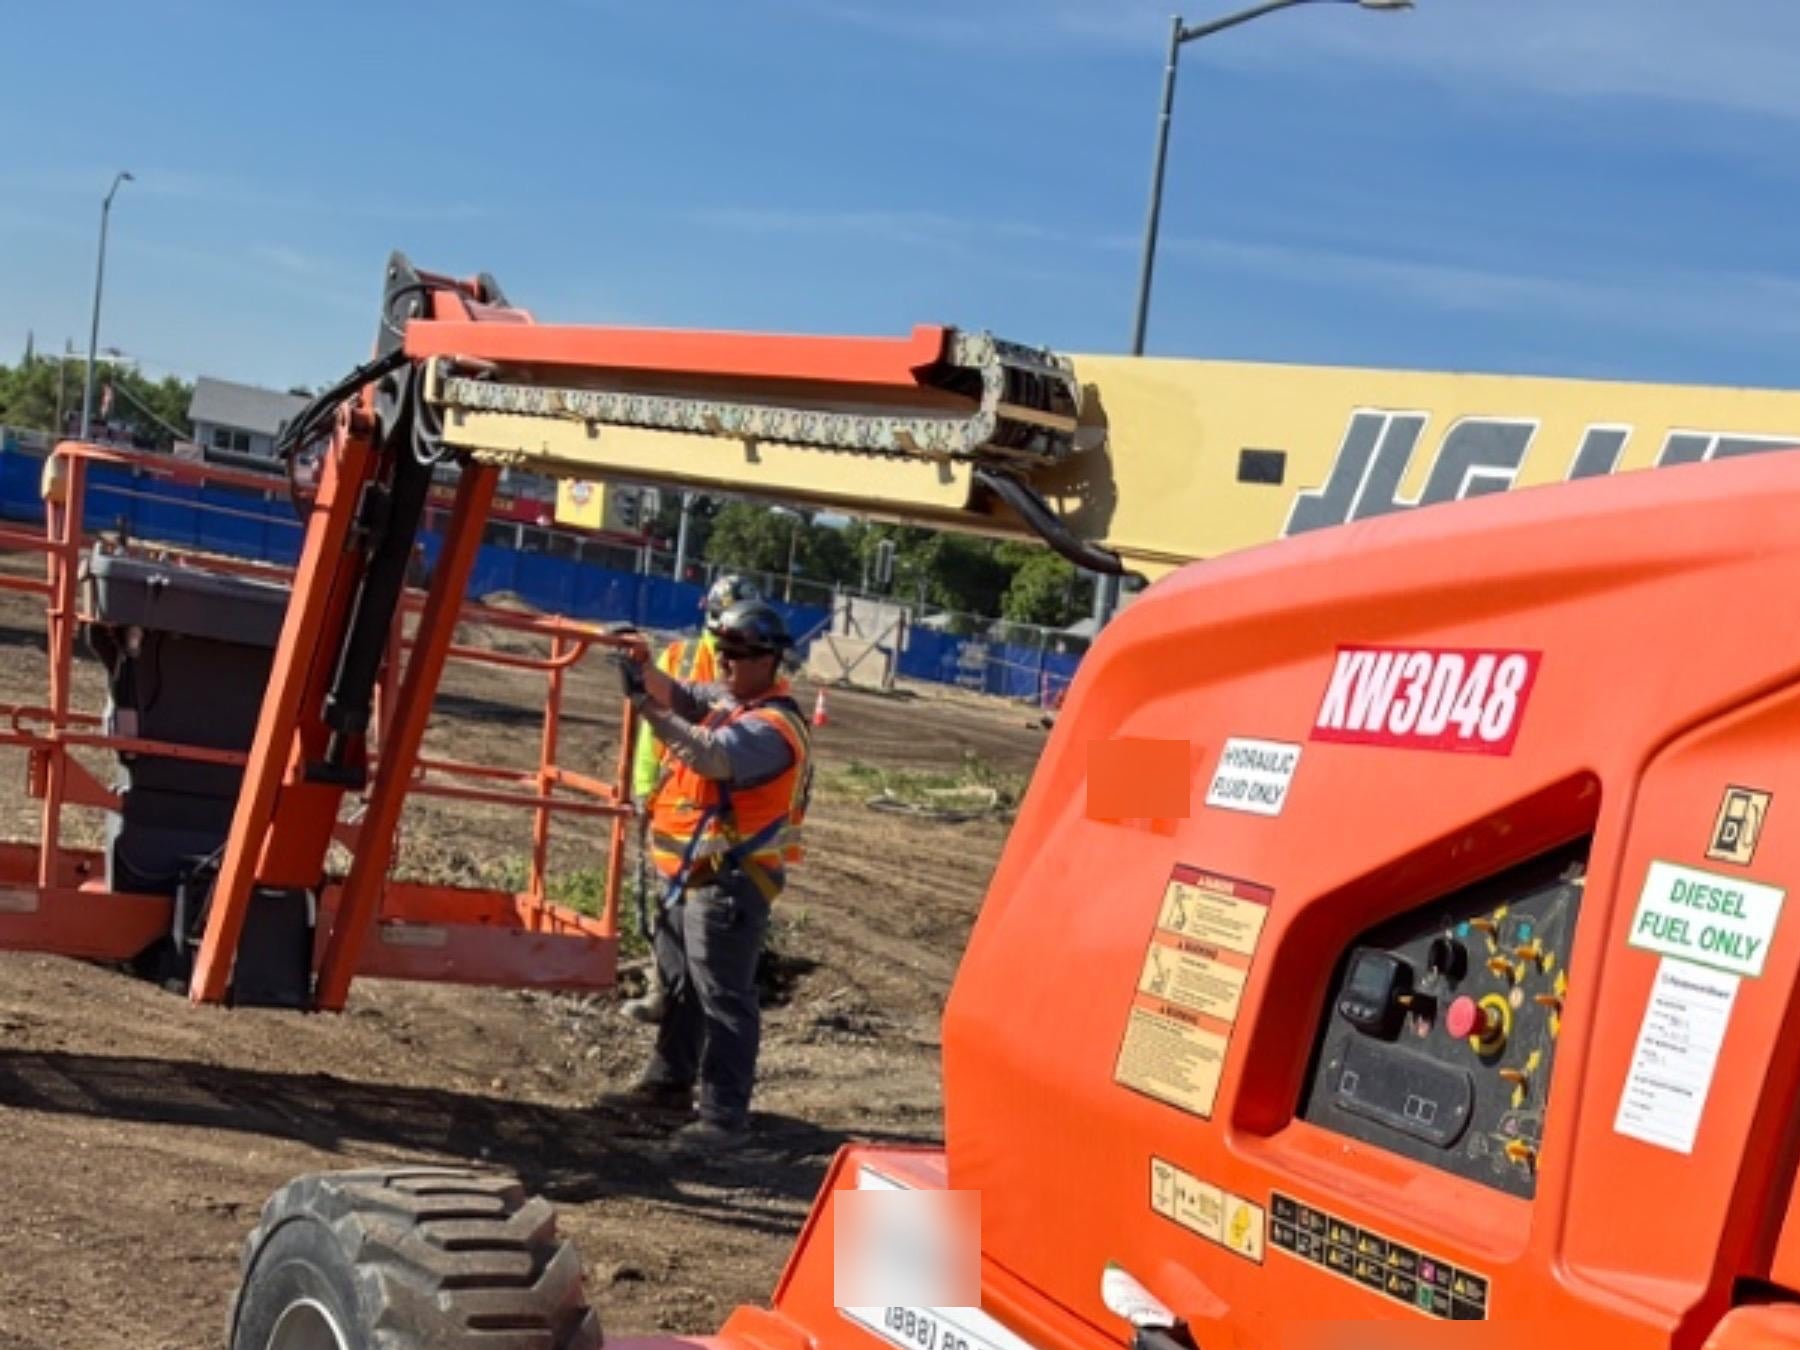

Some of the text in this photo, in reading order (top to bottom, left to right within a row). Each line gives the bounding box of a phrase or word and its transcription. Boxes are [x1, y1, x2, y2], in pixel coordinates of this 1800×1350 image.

[1315, 650, 1528, 742] KW3D48
[1226, 747, 1295, 774] HYDRAULIC
[1212, 776, 1284, 805] FLUID ONLY
[1669, 878, 1747, 919] DIESEL
[1637, 911, 1762, 962] FUEL ONLY
[885, 1307, 937, 1350] (888)
